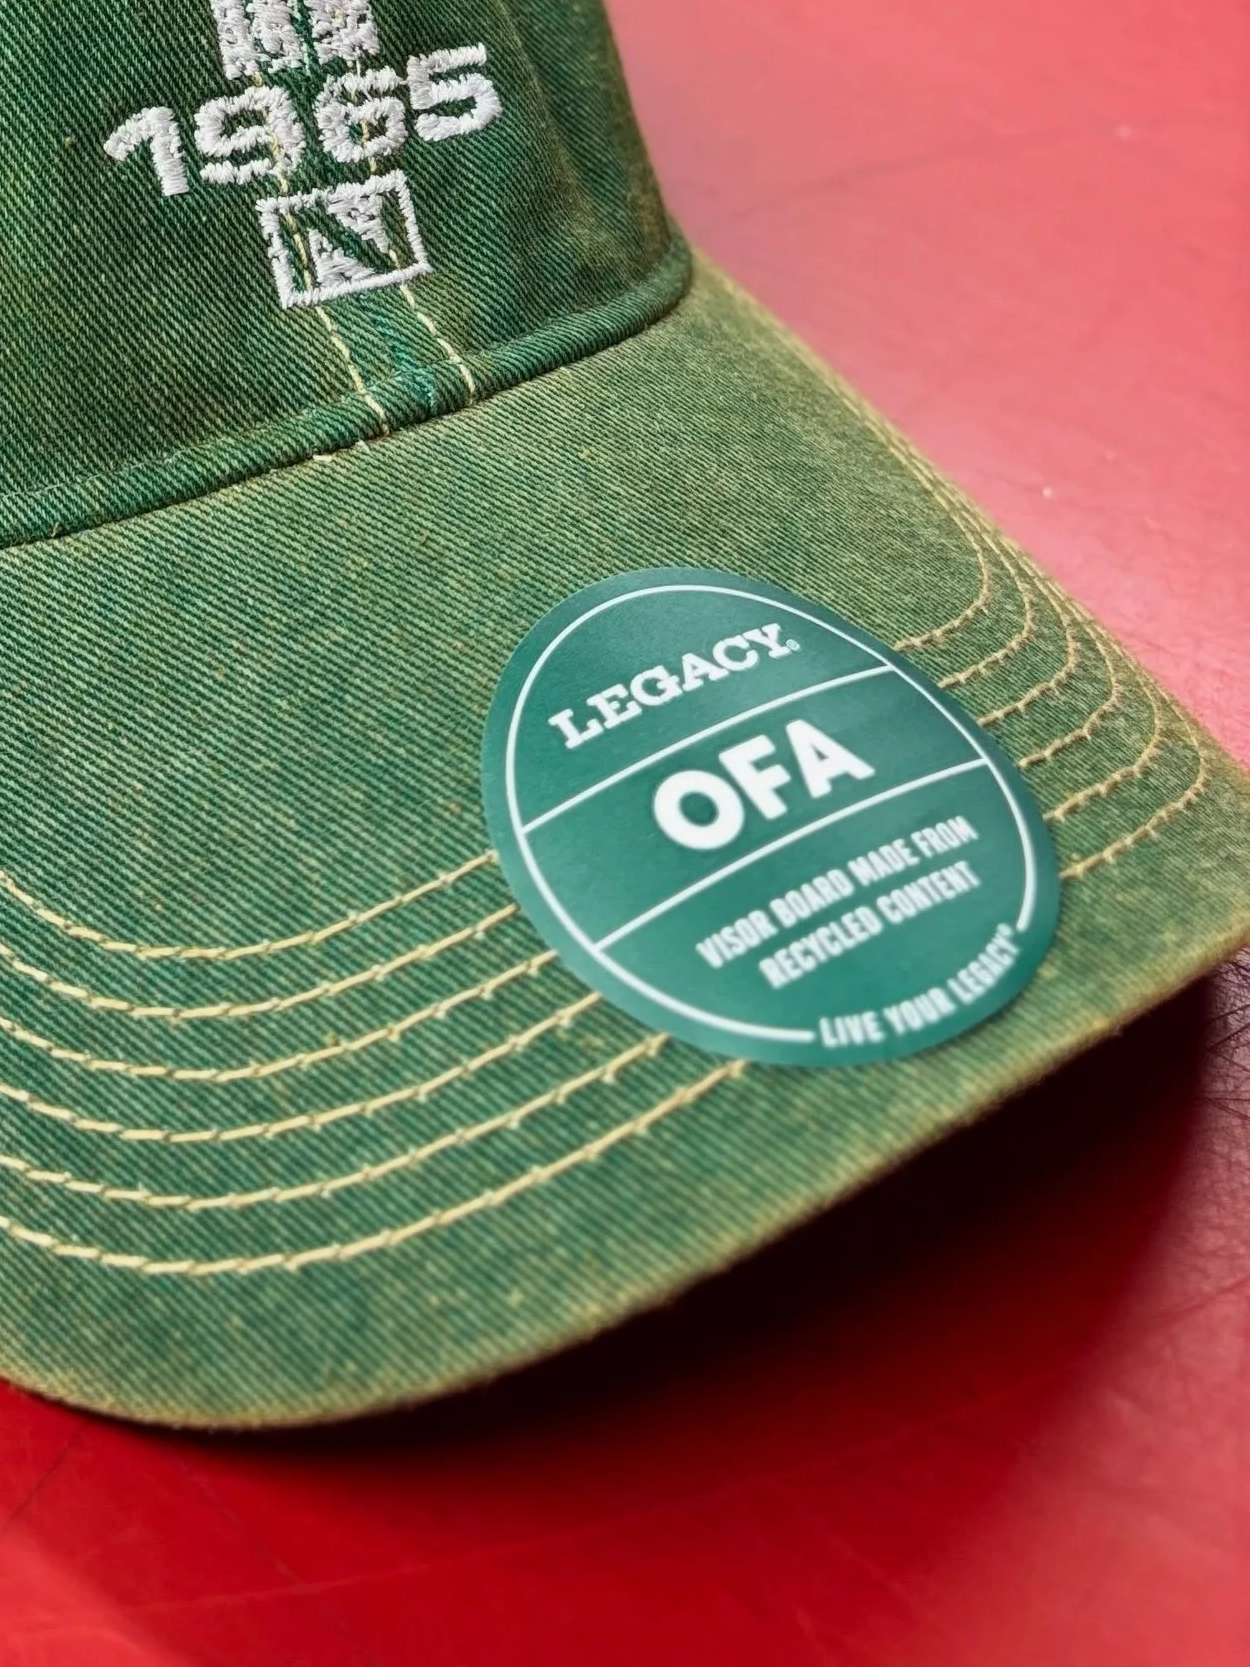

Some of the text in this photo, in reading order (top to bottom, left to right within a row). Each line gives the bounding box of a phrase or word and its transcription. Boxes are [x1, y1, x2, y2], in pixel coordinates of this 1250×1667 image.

[103, 42, 503, 196] 1965
[653, 719, 876, 851] OFA
[695, 814, 979, 969] VISOR BOARD MADE FROM
[758, 860, 982, 990] RECYCLED CONTENT
[818, 1009, 887, 1049] LIVE
[881, 986, 957, 1036] YOUR
